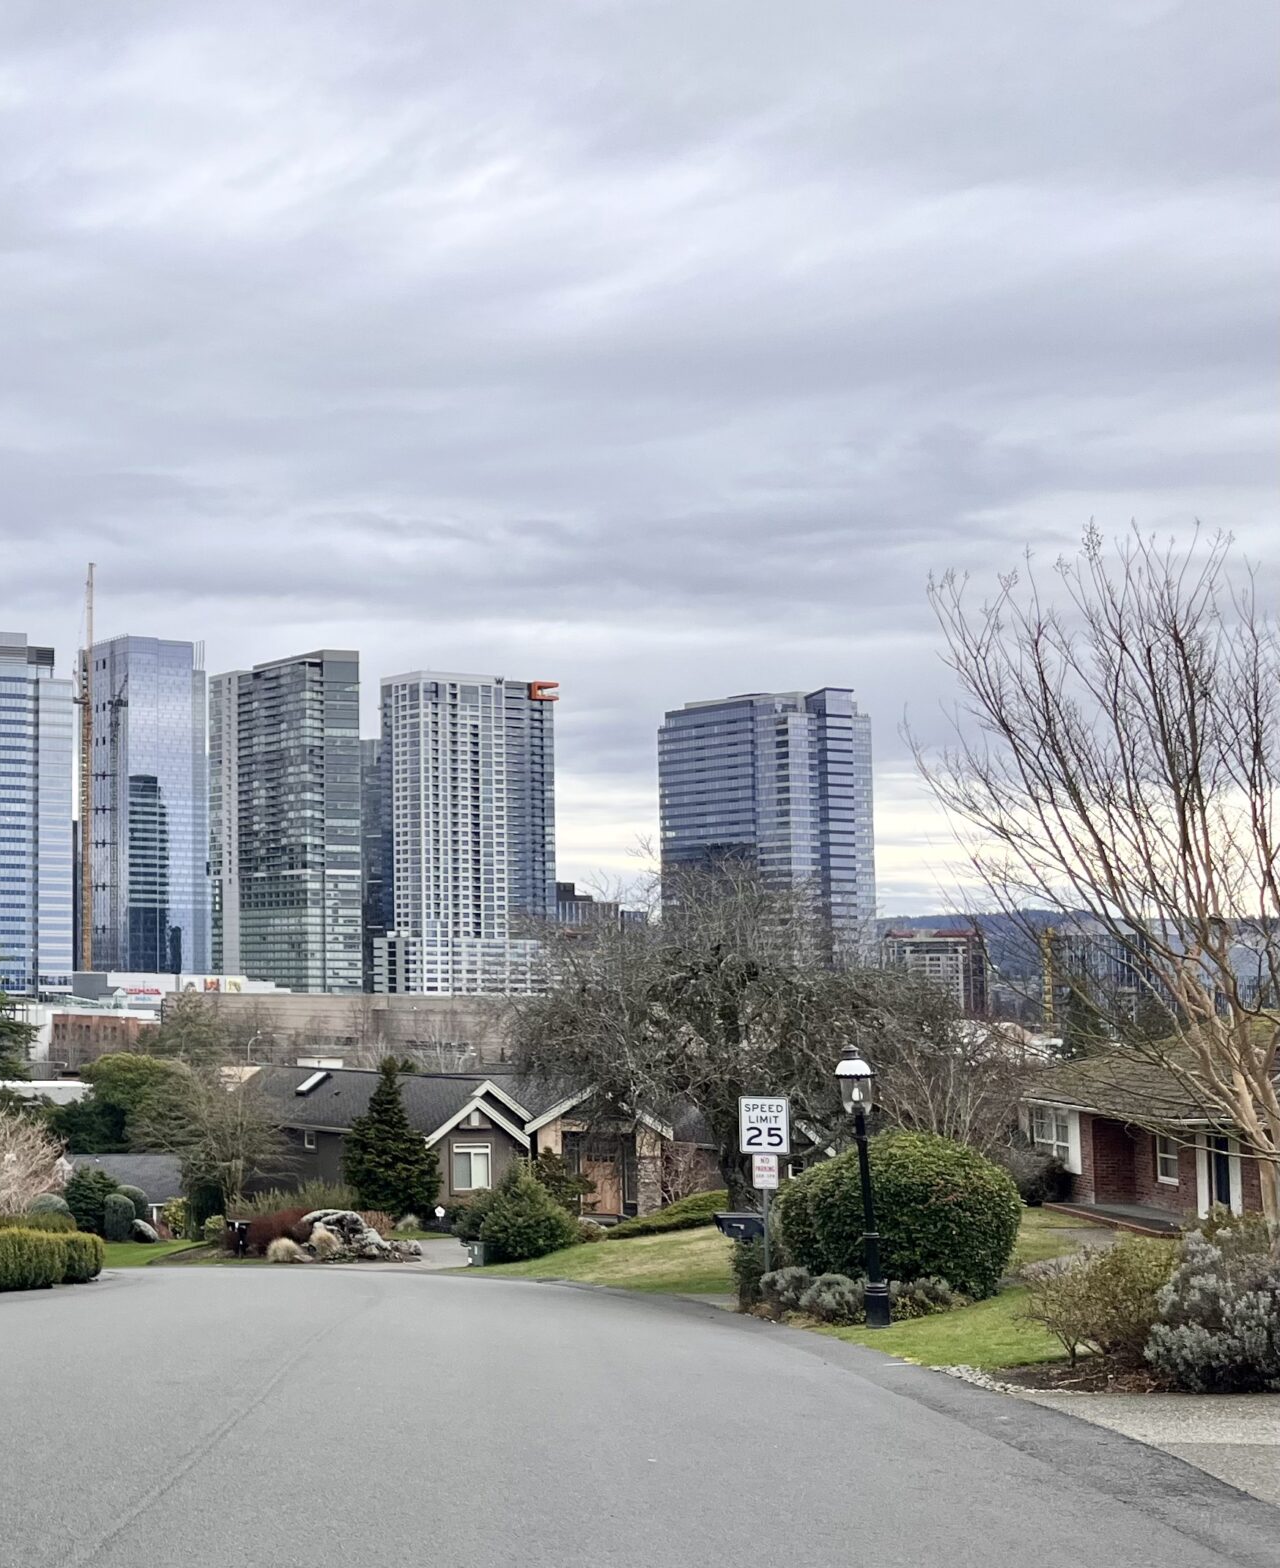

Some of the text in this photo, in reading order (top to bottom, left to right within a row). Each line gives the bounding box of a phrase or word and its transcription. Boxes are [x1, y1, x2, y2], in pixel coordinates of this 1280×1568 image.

[494, 677, 504, 685] W
[744, 1104, 783, 1113] SPEED
[748, 1115, 779, 1124] LIMIT
[746, 1126, 783, 1147] 25
